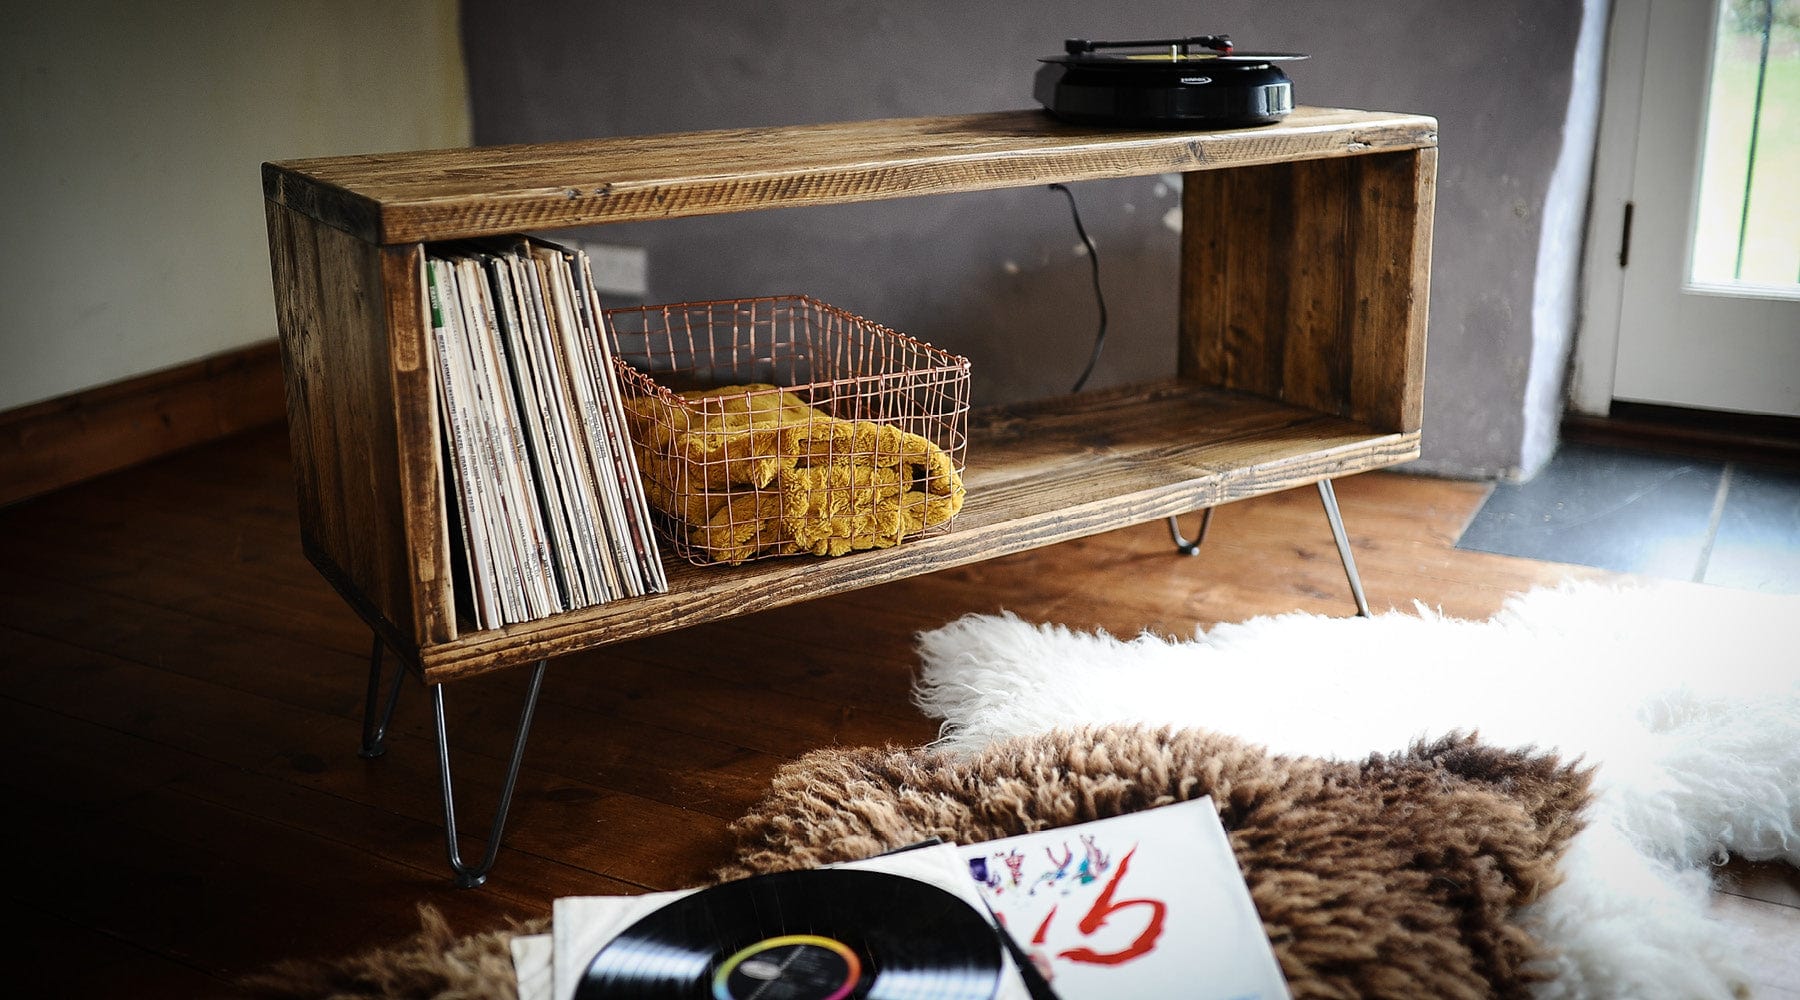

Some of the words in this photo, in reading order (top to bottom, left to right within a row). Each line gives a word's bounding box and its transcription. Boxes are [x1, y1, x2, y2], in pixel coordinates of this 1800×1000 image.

[428, 285, 437, 307] ERATO
[437, 334, 445, 352] BIZET
[442, 358, 451, 385] CARMEN
[454, 425, 463, 450] MAAZEL
[460, 455, 468, 476] ERATO
